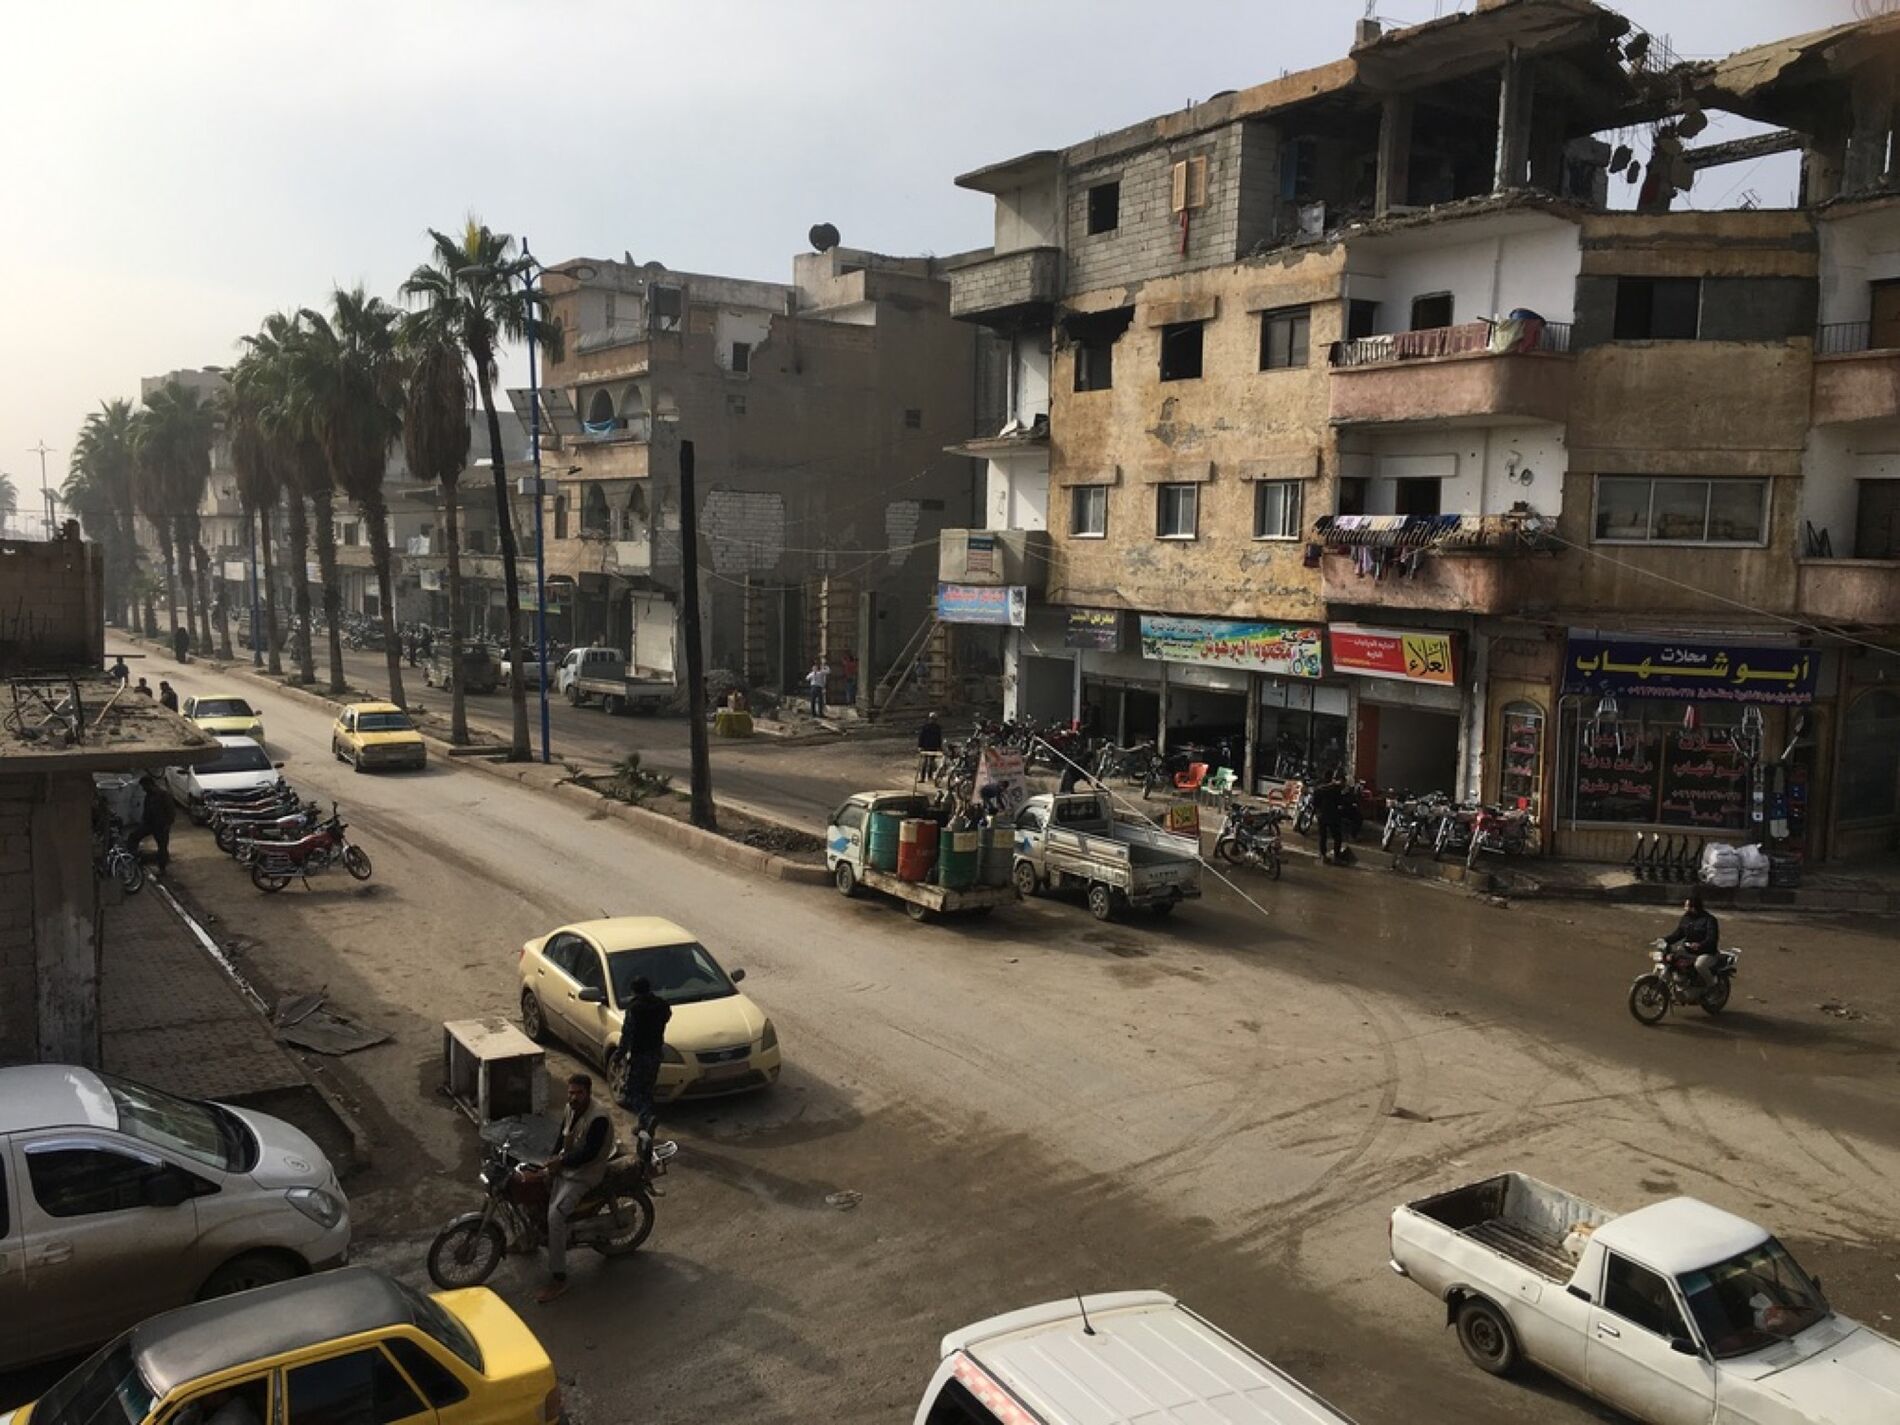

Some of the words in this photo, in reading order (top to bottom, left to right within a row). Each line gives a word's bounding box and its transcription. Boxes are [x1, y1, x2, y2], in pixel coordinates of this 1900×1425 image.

[1576, 650, 1730, 681] شهاب
[1660, 647, 1708, 663] محلات
[1731, 654, 1810, 688] أبو
